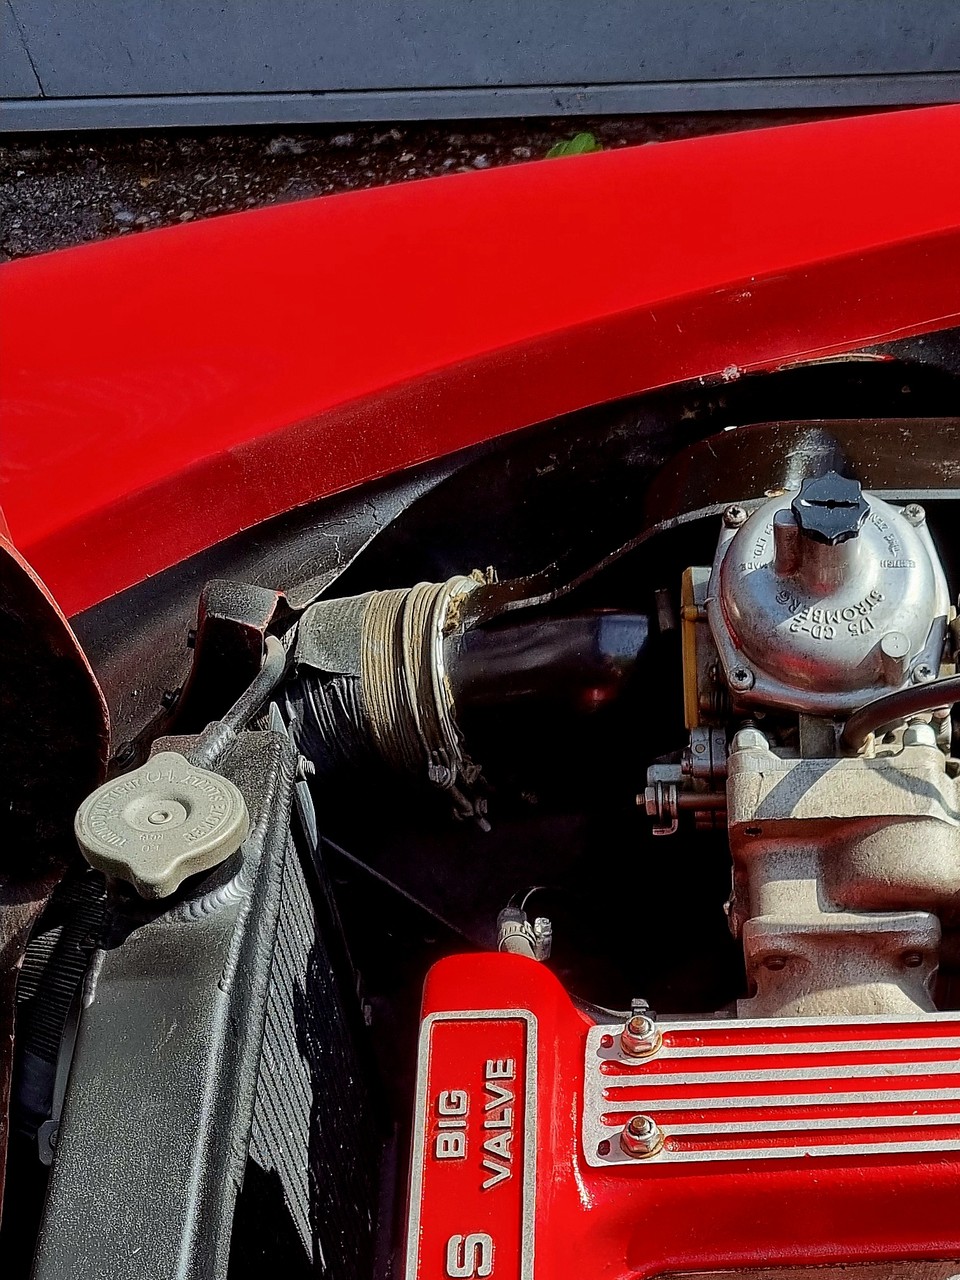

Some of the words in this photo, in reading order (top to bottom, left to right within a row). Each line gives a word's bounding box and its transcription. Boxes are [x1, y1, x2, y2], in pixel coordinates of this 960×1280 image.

[775, 589, 887, 625] STROMBERG
[435, 1088, 470, 1161] BIG
[482, 1057, 515, 1191] VALVE
